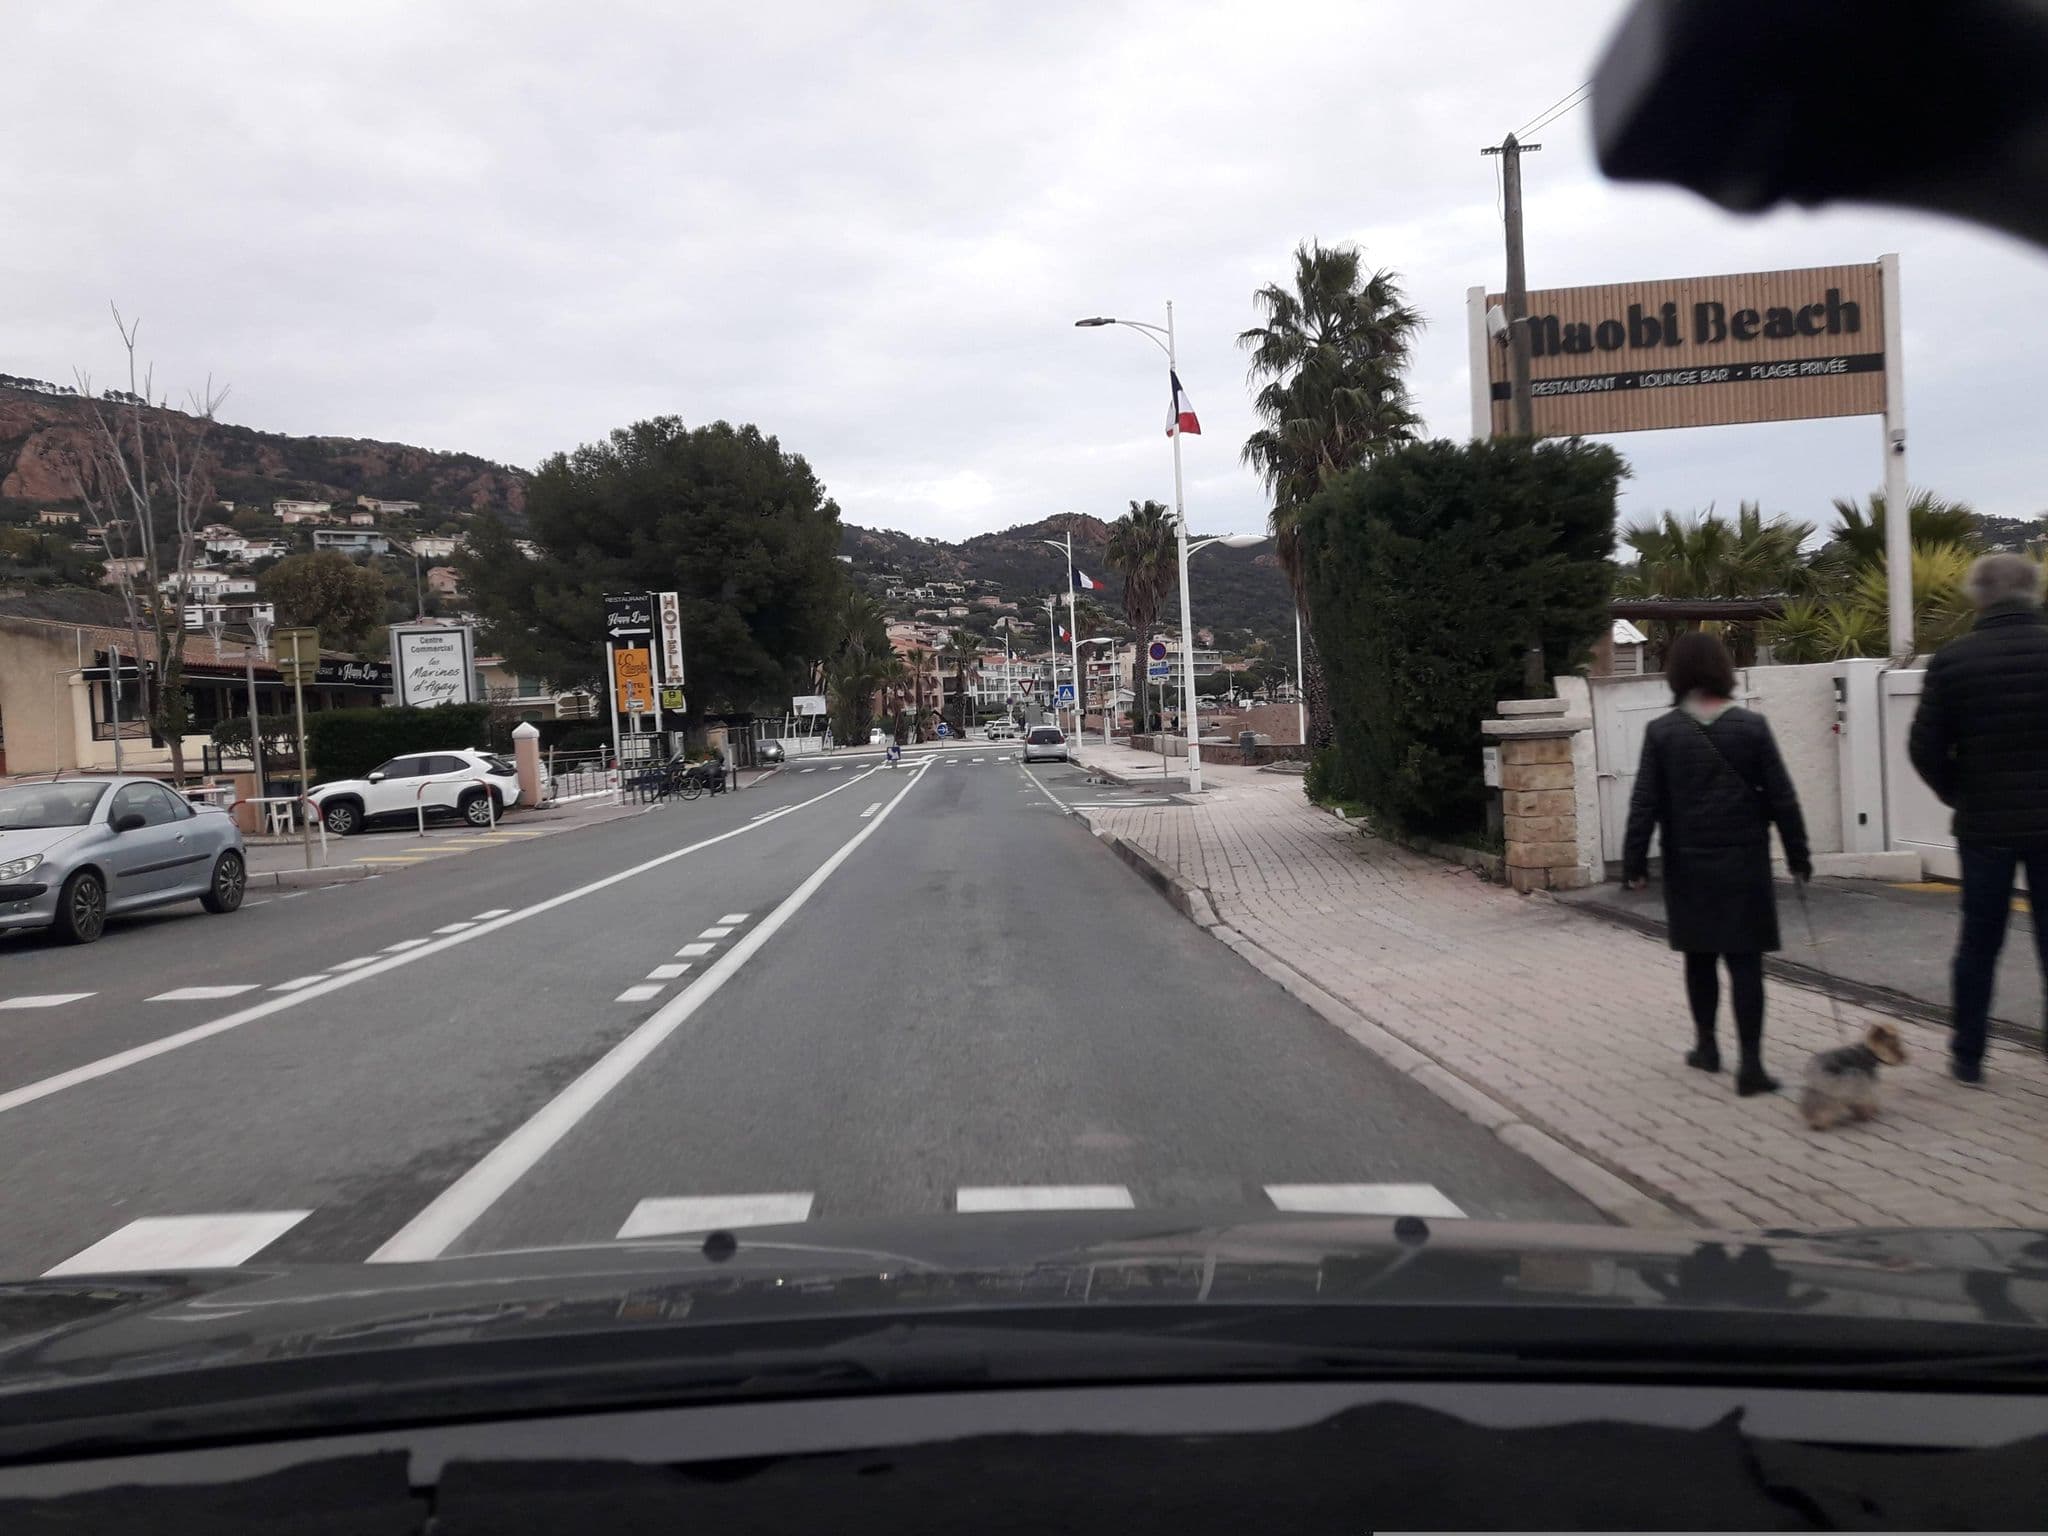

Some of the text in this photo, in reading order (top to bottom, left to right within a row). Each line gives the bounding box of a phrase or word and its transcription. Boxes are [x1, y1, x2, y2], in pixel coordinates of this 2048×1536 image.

[1695, 288, 1861, 345] Beach
[1531, 357, 1848, 396] RESTAURANT LOUNGE BAR PLAGE PRIVÉE
[662, 595, 680, 669] HOTEL
[411, 645, 454, 653] Commercial
[409, 667, 460, 679] Marines
[413, 679, 460, 697] d'Agay
[621, 682, 645, 690] HTEL
